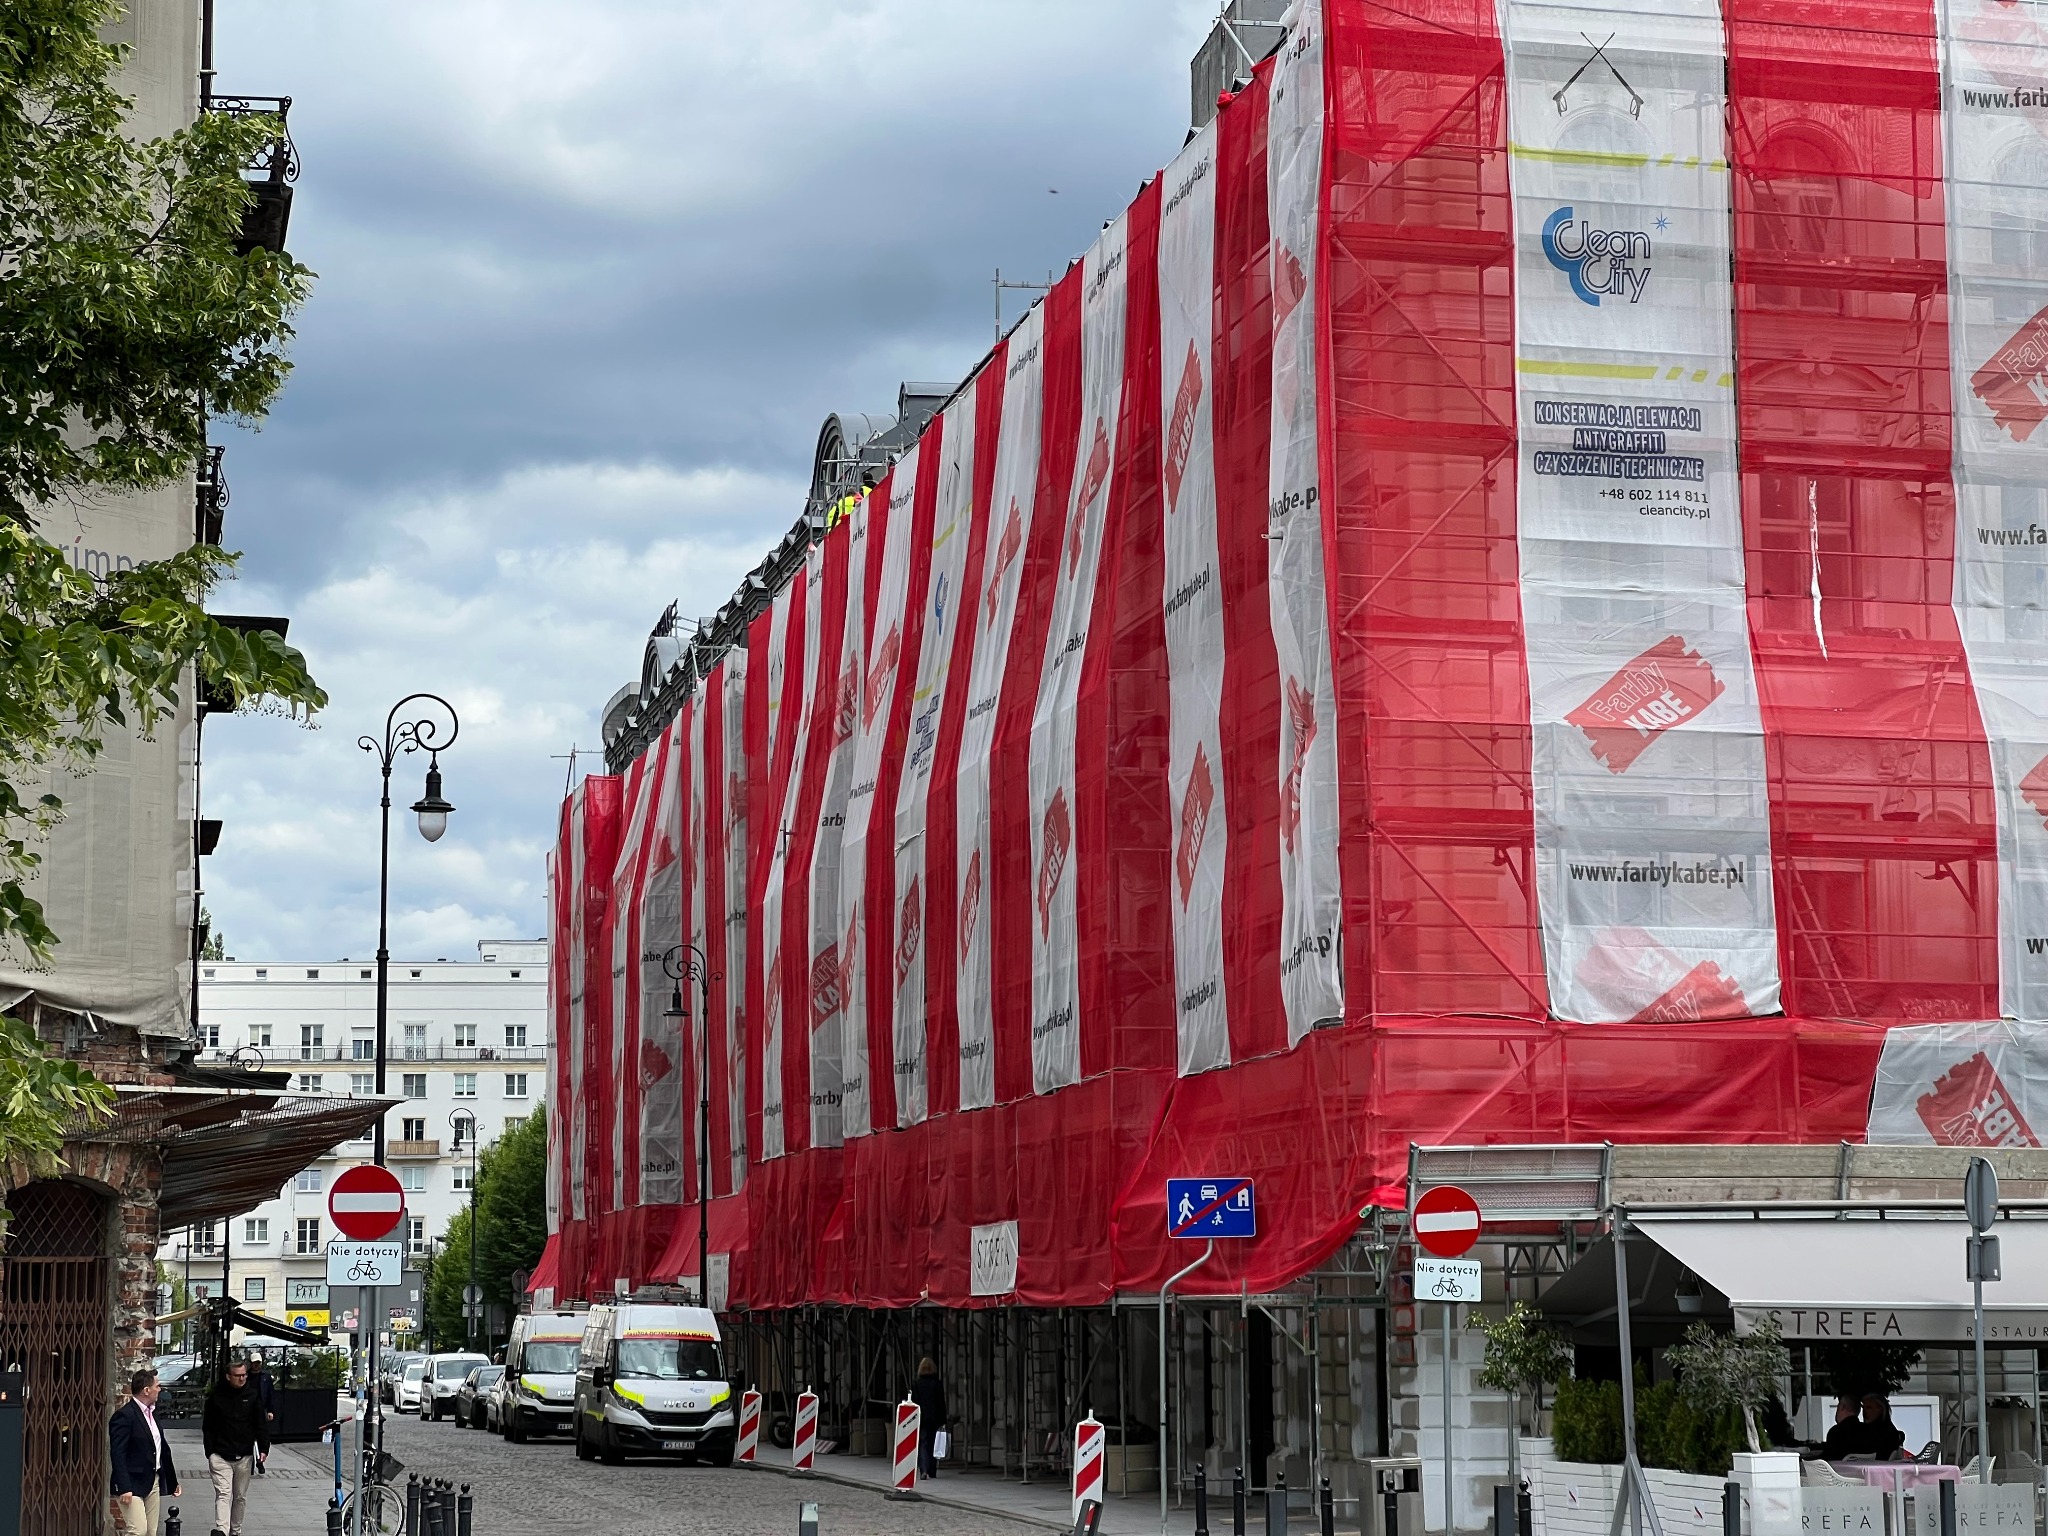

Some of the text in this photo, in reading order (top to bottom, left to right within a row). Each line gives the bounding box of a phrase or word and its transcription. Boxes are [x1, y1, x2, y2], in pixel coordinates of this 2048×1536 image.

[1553, 219, 1651, 260] Clean
[1580, 255, 1651, 304] City
[1535, 402, 1701, 431] KONSERWACJA ELEWACJI
[1574, 428, 1666, 453] ANTYGRAFFITI
[1535, 451, 1704, 480] CZYSZCZENIE TECHNICZNE
[1599, 488, 1709, 504] +48 602 114 811
[1639, 504, 1711, 520] cleancity.pl
[1587, 661, 1670, 722] Farby
[1623, 690, 1693, 739] KABE
[1569, 861, 1744, 889] www.farbykabe.pl
[330, 1245, 399, 1259] Nie dotyczy
[1416, 1262, 1479, 1278] Nie dotyczy
[1966, 1326, 2048, 1338] RSTAUR
[663, 1399, 695, 1409] IVECO
[1928, 1511, 2023, 1528] SREFA
